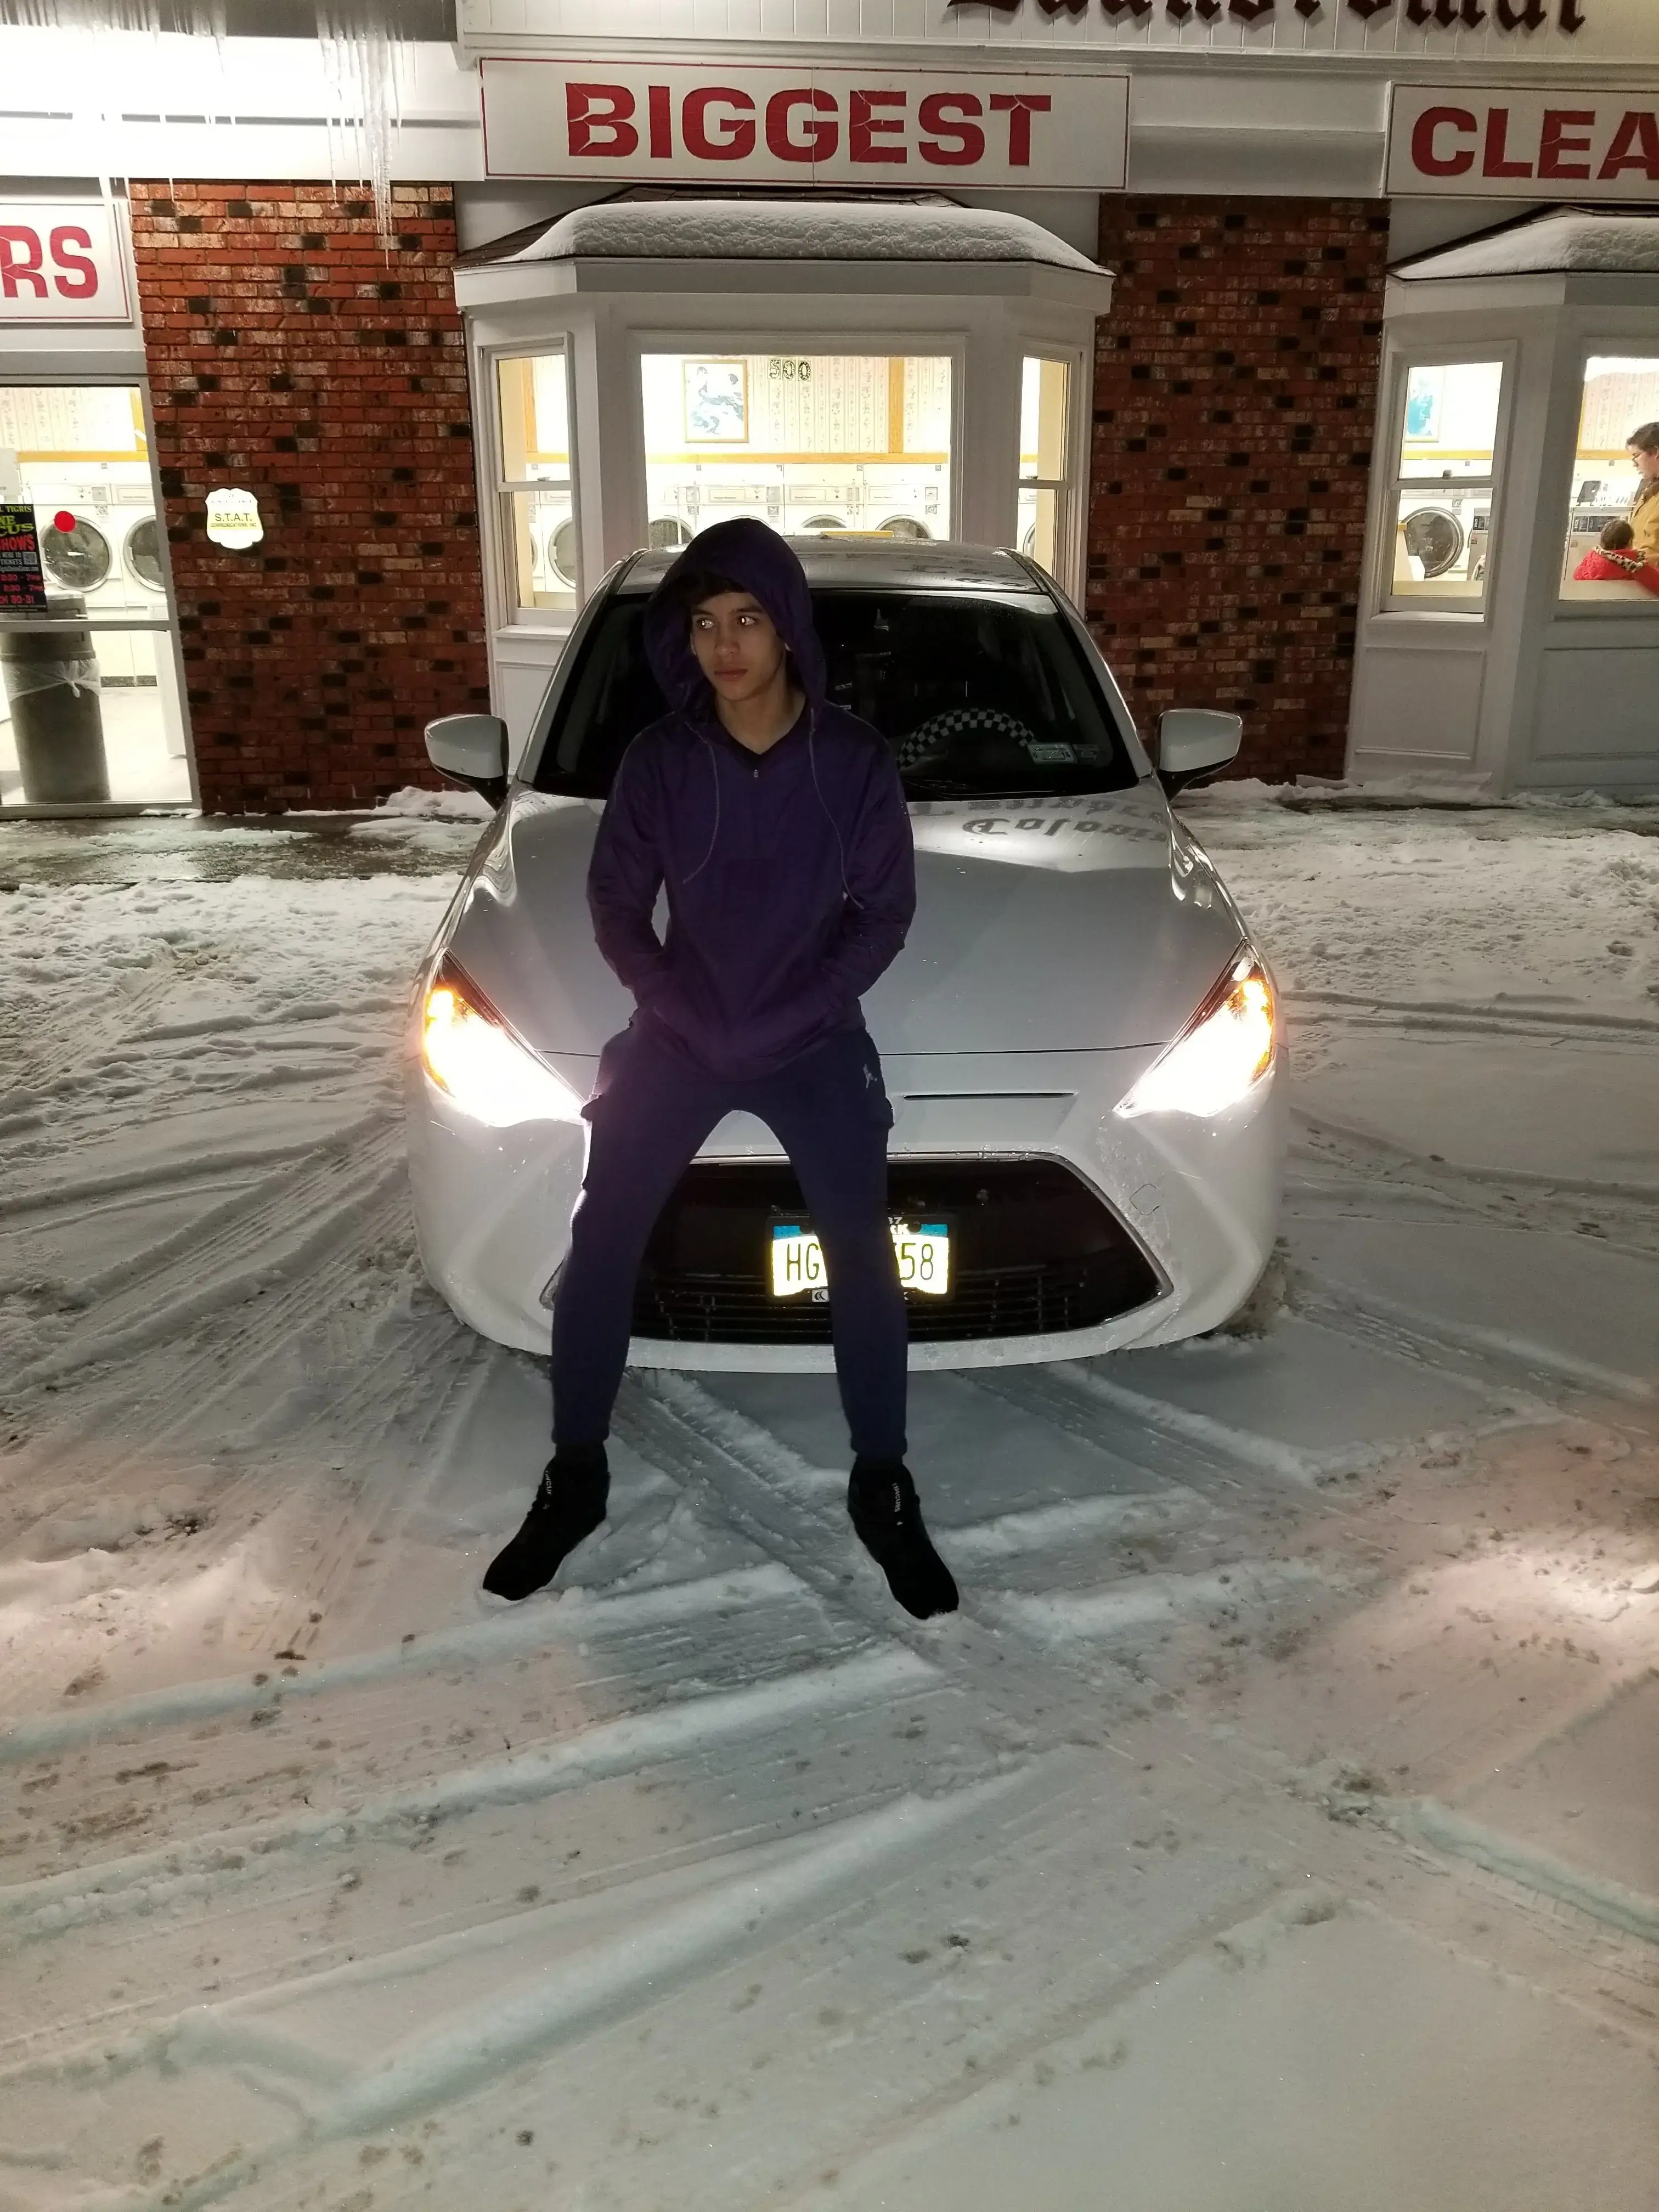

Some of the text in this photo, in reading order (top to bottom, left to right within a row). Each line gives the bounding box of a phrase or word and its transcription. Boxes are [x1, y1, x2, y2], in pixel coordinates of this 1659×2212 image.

[565, 82, 1052, 167] BIGGEST
[1412, 106, 1659, 180] CLEA
[0, 225, 98, 299] RS
[769, 359, 811, 380] 500
[215, 513, 252, 522] S.T.A.T.
[0, 534, 35, 551] HOWS
[894, 1242, 934, 1281] 58
